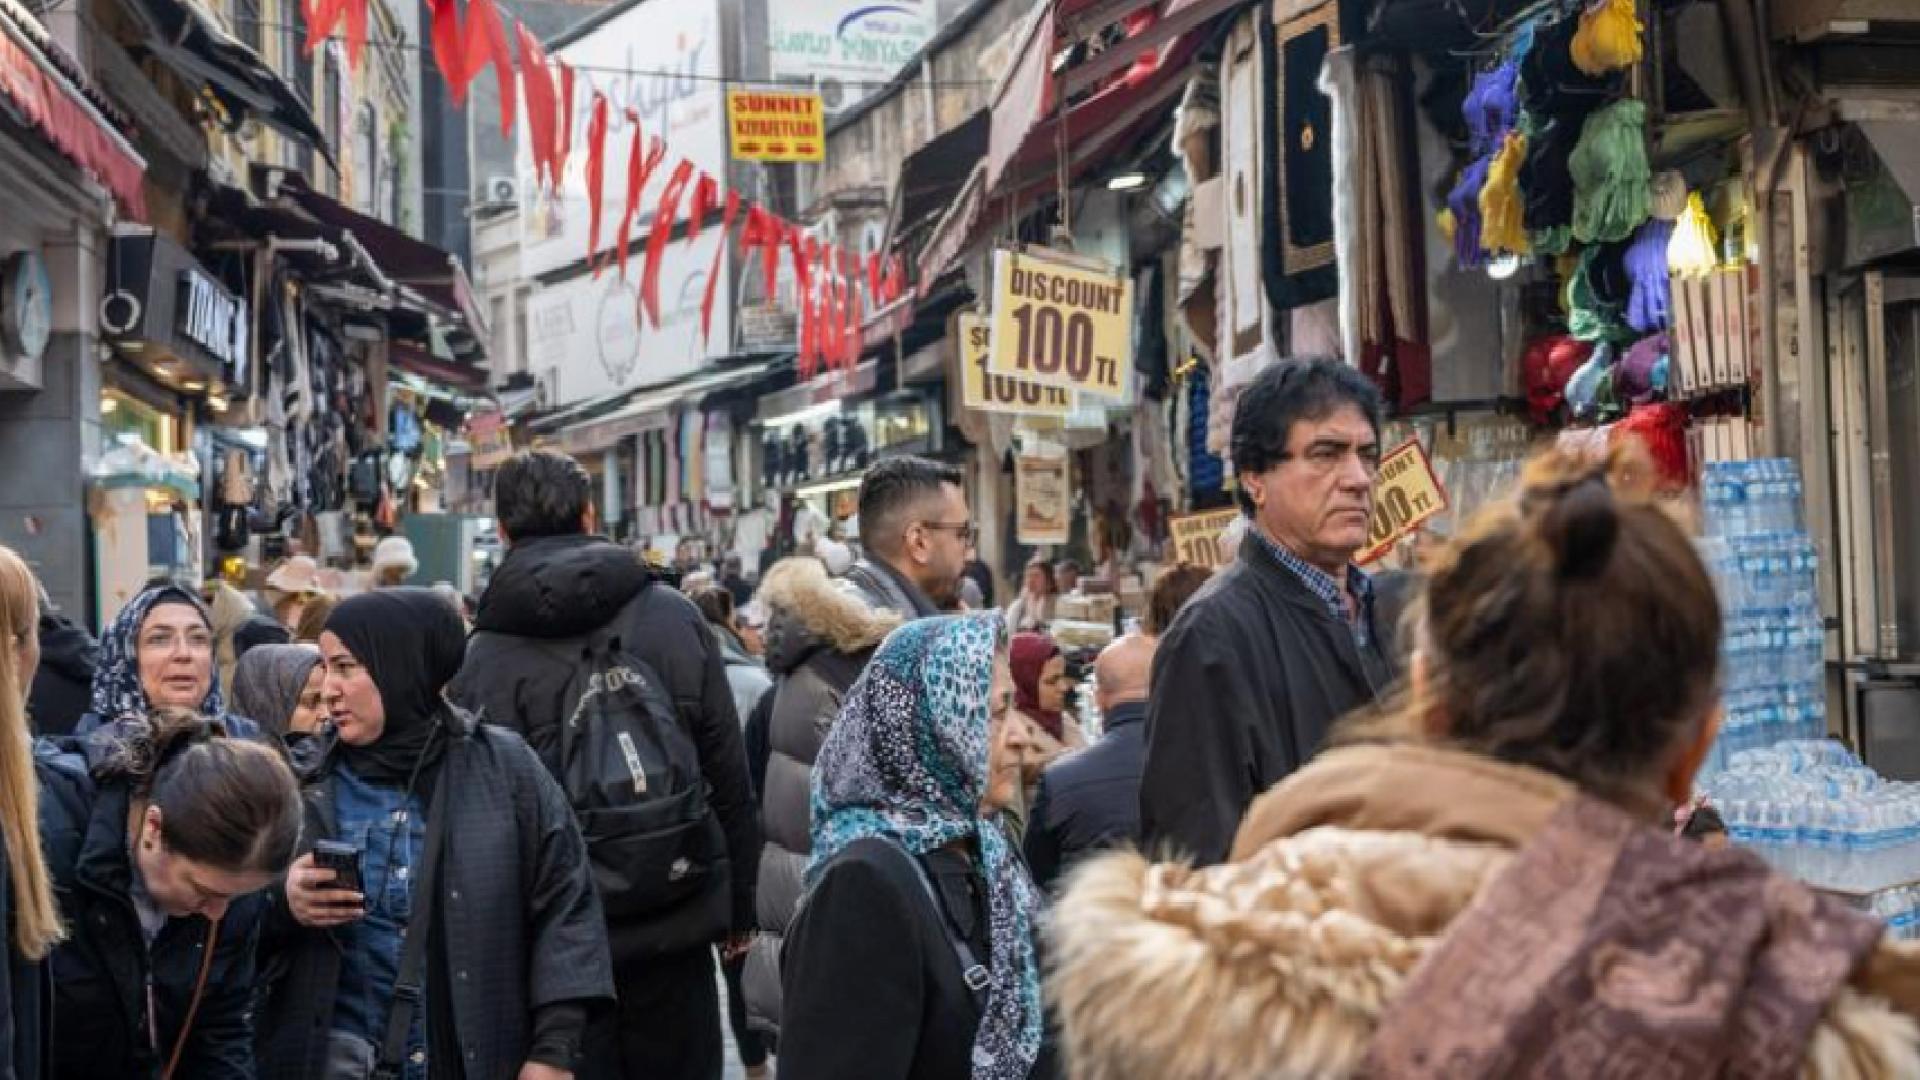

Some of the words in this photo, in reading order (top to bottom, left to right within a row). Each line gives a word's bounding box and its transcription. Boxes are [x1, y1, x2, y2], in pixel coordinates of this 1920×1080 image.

[1010, 268, 1124, 315] DISCOUNT
[1012, 303, 1093, 382] 100
[1095, 355, 1118, 386] TL
